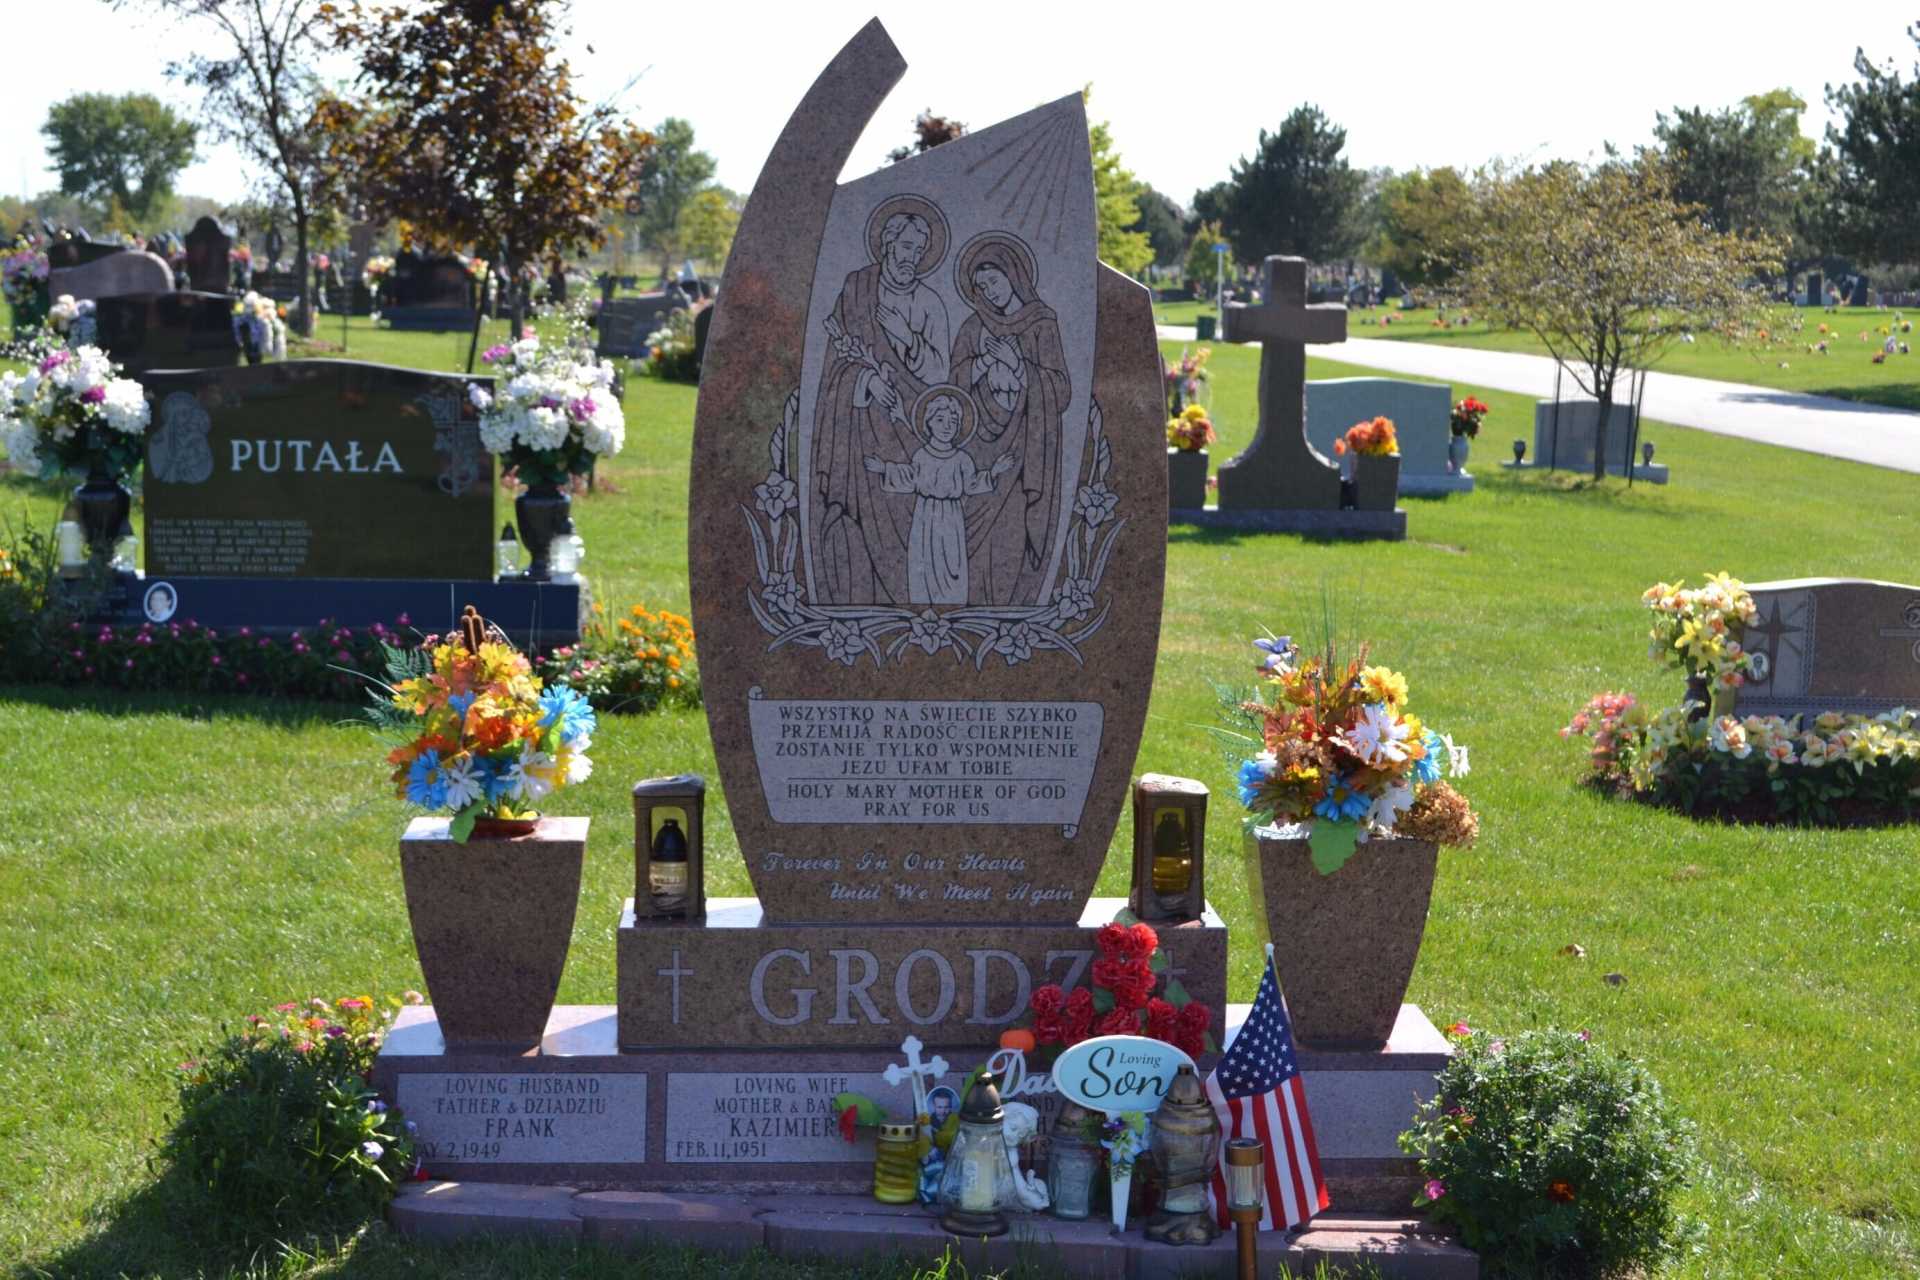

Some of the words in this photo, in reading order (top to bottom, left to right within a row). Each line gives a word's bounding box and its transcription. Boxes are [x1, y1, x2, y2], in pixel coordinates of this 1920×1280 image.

[230, 439, 404, 473] PUTAŁA
[778, 706, 875, 723] WSZYSTKO
[885, 706, 910, 721] NA
[920, 703, 996, 722] ŚWIECIE
[1007, 707, 1077, 722] SZYBKO
[884, 722, 957, 740] RADOŚĆ
[968, 725, 1073, 740] CIERPIENIE
[776, 742, 865, 757] ZOSTANIE
[878, 742, 938, 757] TYLKO
[950, 743, 1079, 758] WSPOMNIENIE
[841, 760, 886, 775] JEZU
[899, 760, 949, 775] UFAM
[960, 761, 1013, 776] TOBIE
[788, 784, 834, 798] HOLY
[846, 784, 896, 798] MARY
[909, 784, 983, 799] MOTHER
[995, 785, 1017, 799] OF
[1028, 785, 1066, 799] GOD
[864, 802, 910, 816] PRAY
[923, 802, 956, 817] FOR
[968, 803, 990, 817] US
[762, 851, 842, 872] Forever
[855, 851, 888, 872] In
[903, 851, 945, 872] Our
[958, 852, 1026, 871] Hearts
[829, 881, 881, 901] Until
[894, 882, 929, 901] We
[942, 881, 992, 901] Meet
[1006, 882, 1073, 905] Again
[1119, 1052, 1163, 1068] Loving
[1080, 1046, 1168, 1098] Son
[446, 1078, 508, 1094] LOVING
[519, 1078, 599, 1094] HUSBAND
[735, 1077, 796, 1093] LOVING
[808, 1077, 848, 1094] WIFE
[437, 1098, 500, 1114] FATHER
[507, 1101, 517, 1114] &
[524, 1098, 606, 1114] DZIADZIU
[713, 1097, 783, 1113] MOTHER
[790, 1101, 799, 1113] &
[485, 1118, 555, 1138] FRANK
[730, 1117, 842, 1138] KAZIMIER
